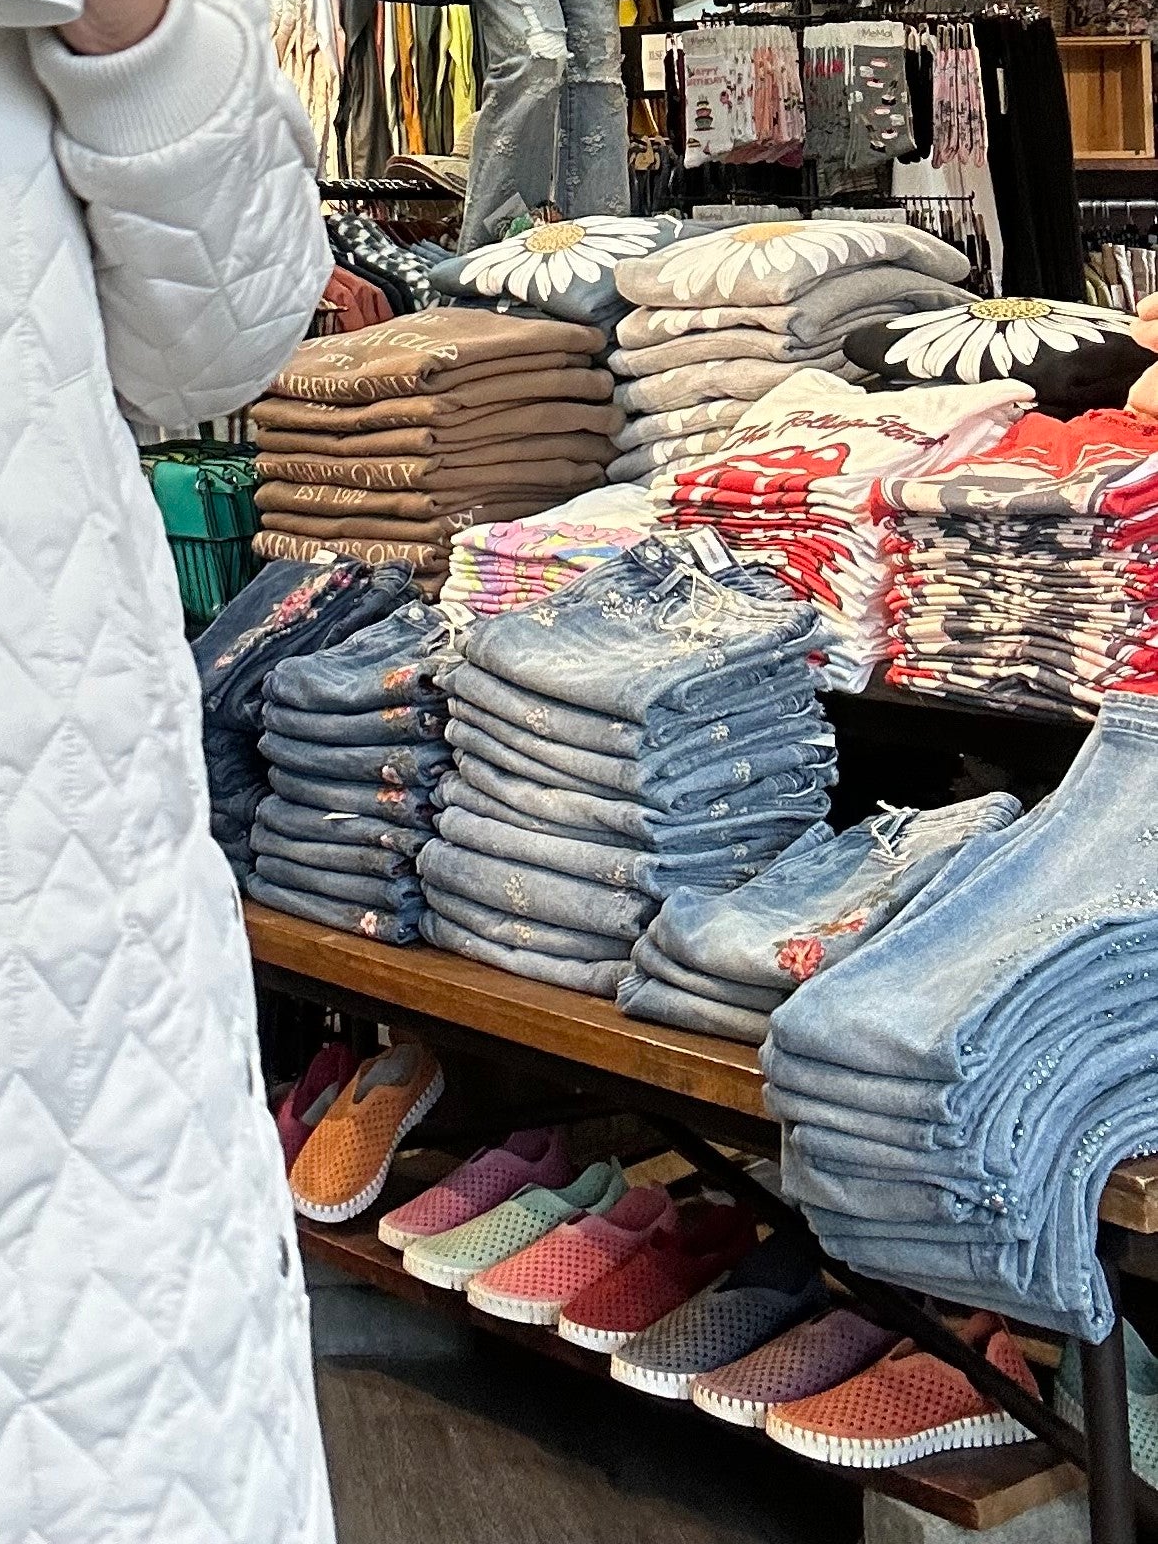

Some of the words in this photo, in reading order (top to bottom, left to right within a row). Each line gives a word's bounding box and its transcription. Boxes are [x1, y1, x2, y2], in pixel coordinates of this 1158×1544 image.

[353, 374, 419, 400] ONLY
[350, 462, 417, 488] ONLY
[332, 487, 368, 504] 1972
[365, 543, 437, 567] ONLY
